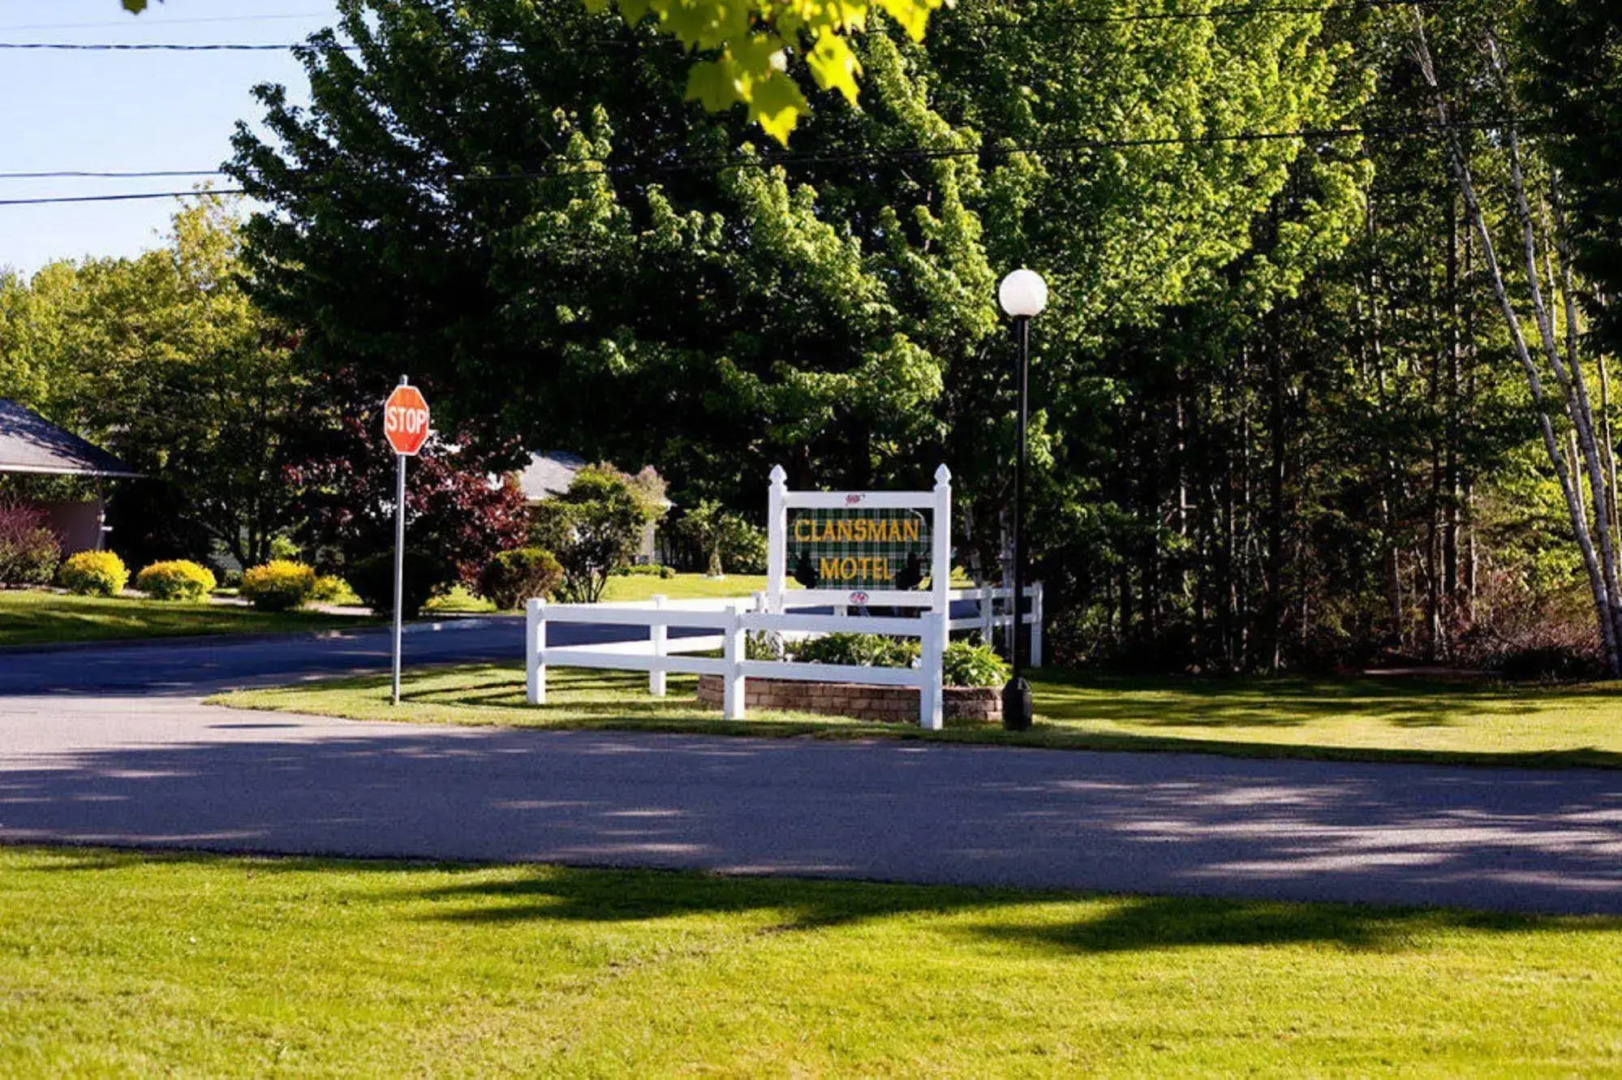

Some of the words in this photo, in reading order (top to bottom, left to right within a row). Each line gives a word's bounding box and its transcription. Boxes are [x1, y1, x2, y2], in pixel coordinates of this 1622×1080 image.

[387, 406, 427, 434] STOP
[794, 518, 919, 542] CLANSMAN
[819, 557, 895, 580] MOTEL
